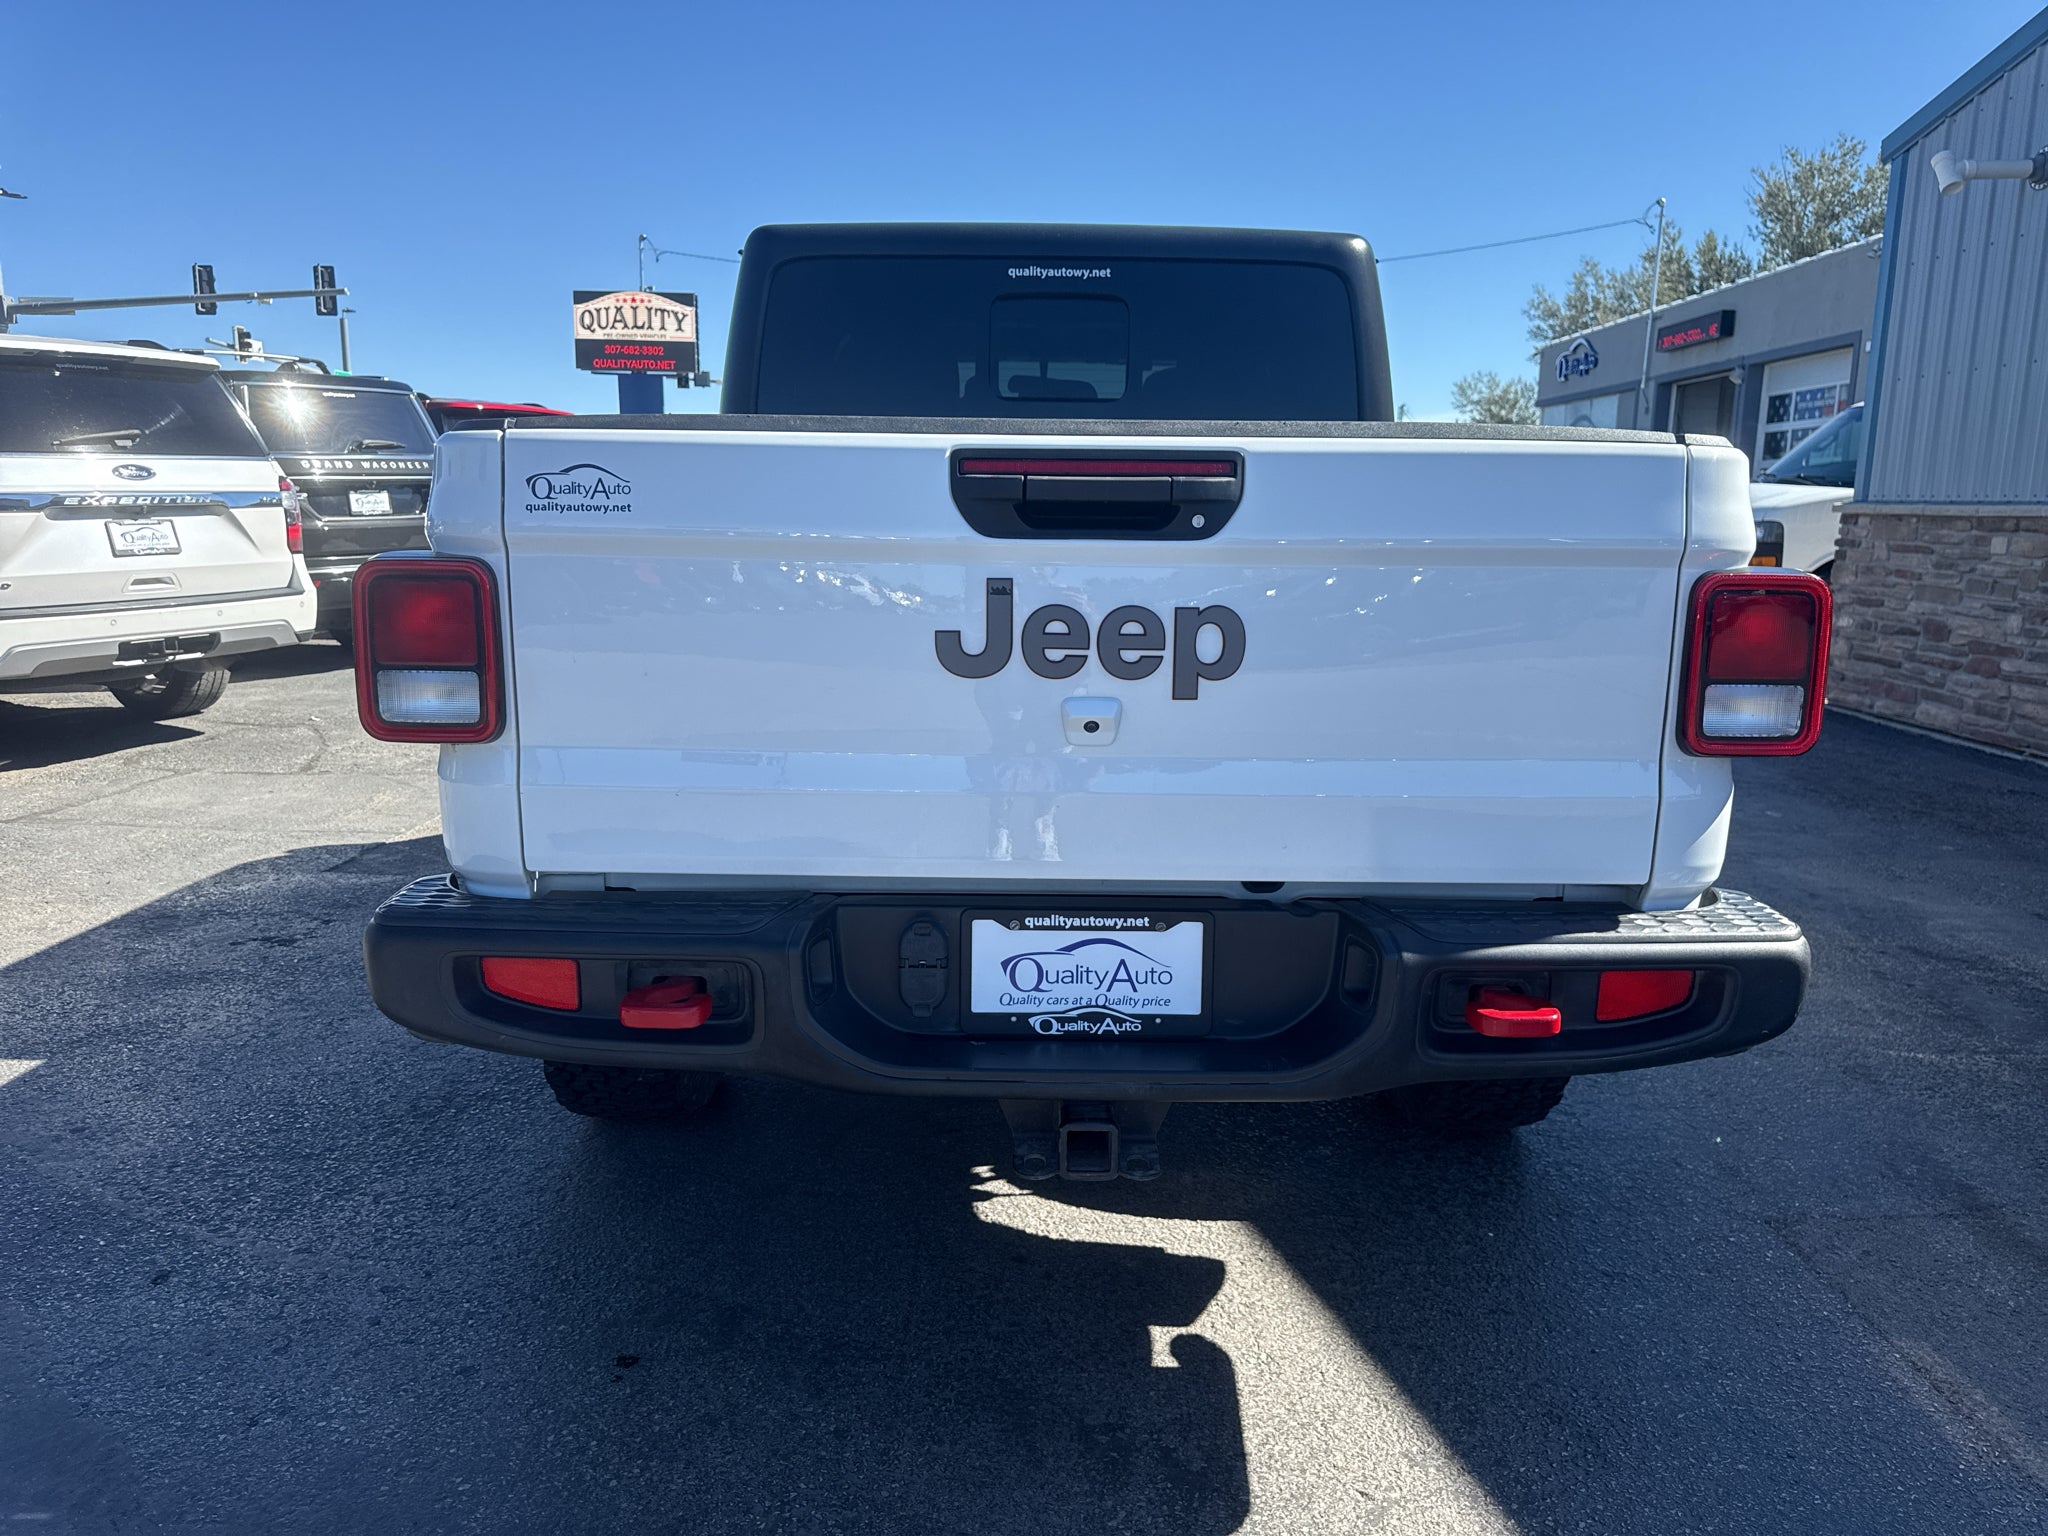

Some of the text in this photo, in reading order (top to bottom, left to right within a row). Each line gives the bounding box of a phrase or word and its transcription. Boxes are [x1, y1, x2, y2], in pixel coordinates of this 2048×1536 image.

[1007, 265, 1112, 280] qualityautowy.net
[579, 305, 689, 333] QUALITY
[604, 344, 664, 356] 307-682-3302
[593, 358, 676, 370] QUALITYAUTO.NET
[300, 459, 430, 470] GRAND WAGONEER
[63, 494, 212, 506] EXPEDITION
[525, 501, 632, 515] qualityautowy.net
[934, 577, 1247, 700] Jeep
[1024, 914, 1150, 930] qualityautowy.net
[999, 992, 1171, 1008] Quality cars at a Quality price
